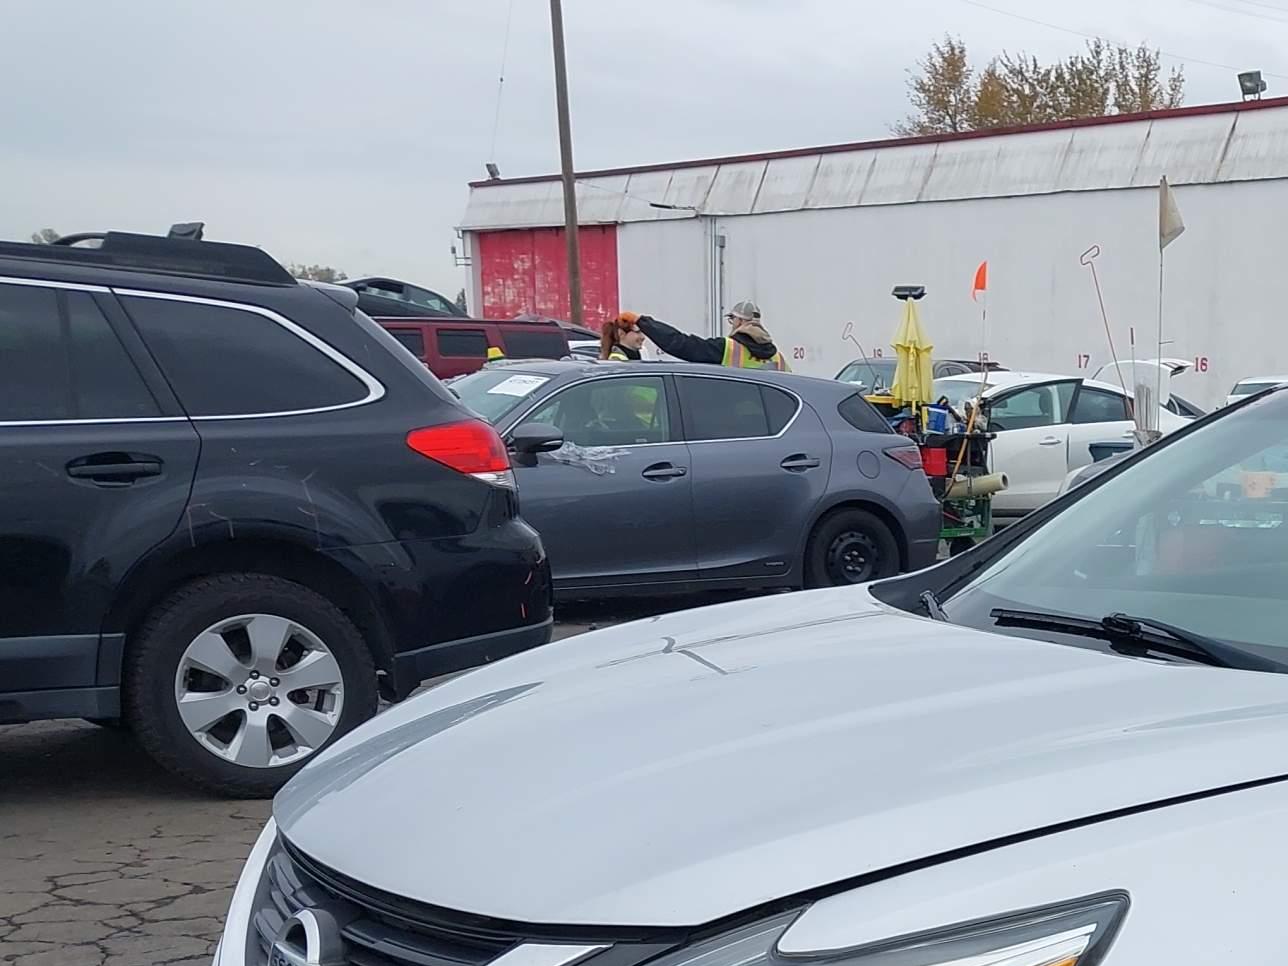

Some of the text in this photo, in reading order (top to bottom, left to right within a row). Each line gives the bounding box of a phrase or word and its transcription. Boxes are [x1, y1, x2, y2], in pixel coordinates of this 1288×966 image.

[793, 347, 805, 359] 20
[1078, 354, 1090, 368] 17
[1195, 357, 1208, 372] 16
